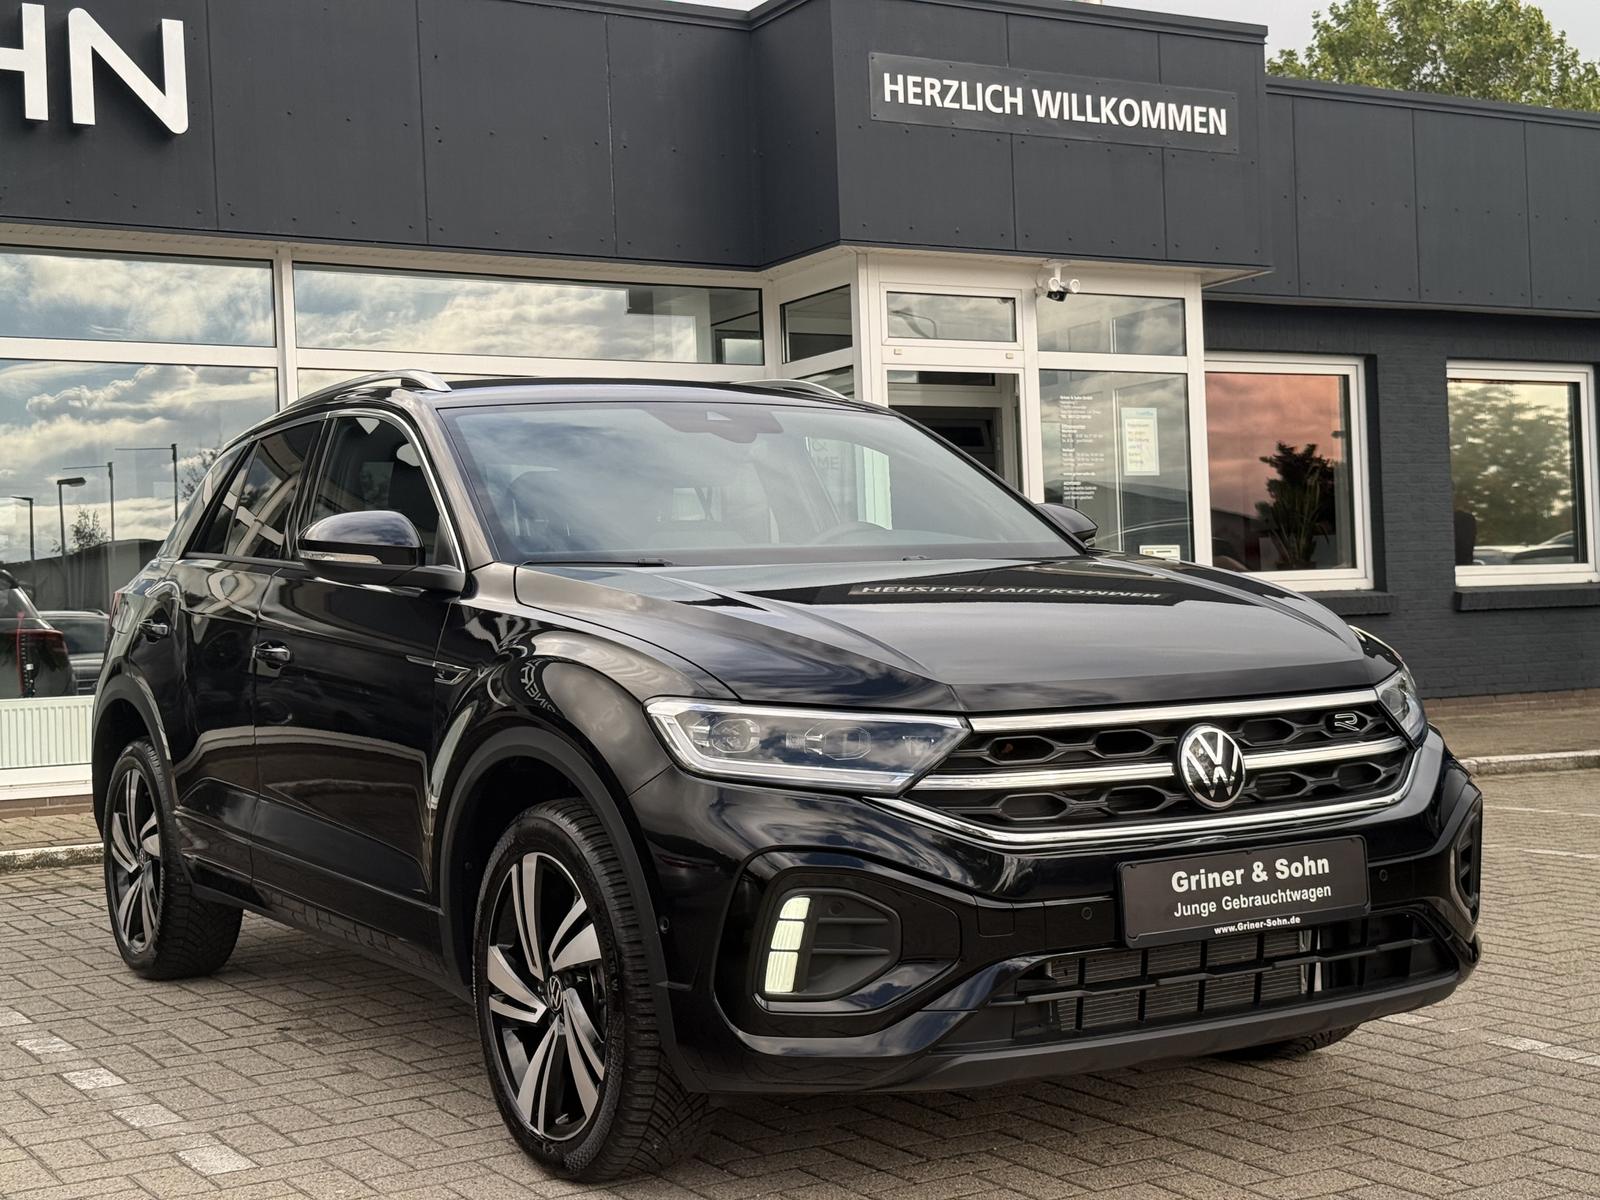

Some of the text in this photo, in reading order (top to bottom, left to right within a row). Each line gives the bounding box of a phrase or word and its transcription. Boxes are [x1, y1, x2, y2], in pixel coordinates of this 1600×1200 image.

[883, 72, 1227, 136] HERZLICH WILLKOMMEN
[1171, 855, 1331, 893] Griner & Sohn
[1173, 885, 1332, 917] Junge Gebrauchtwagen
[1214, 915, 1301, 935] www.Griner-Sohn.de
